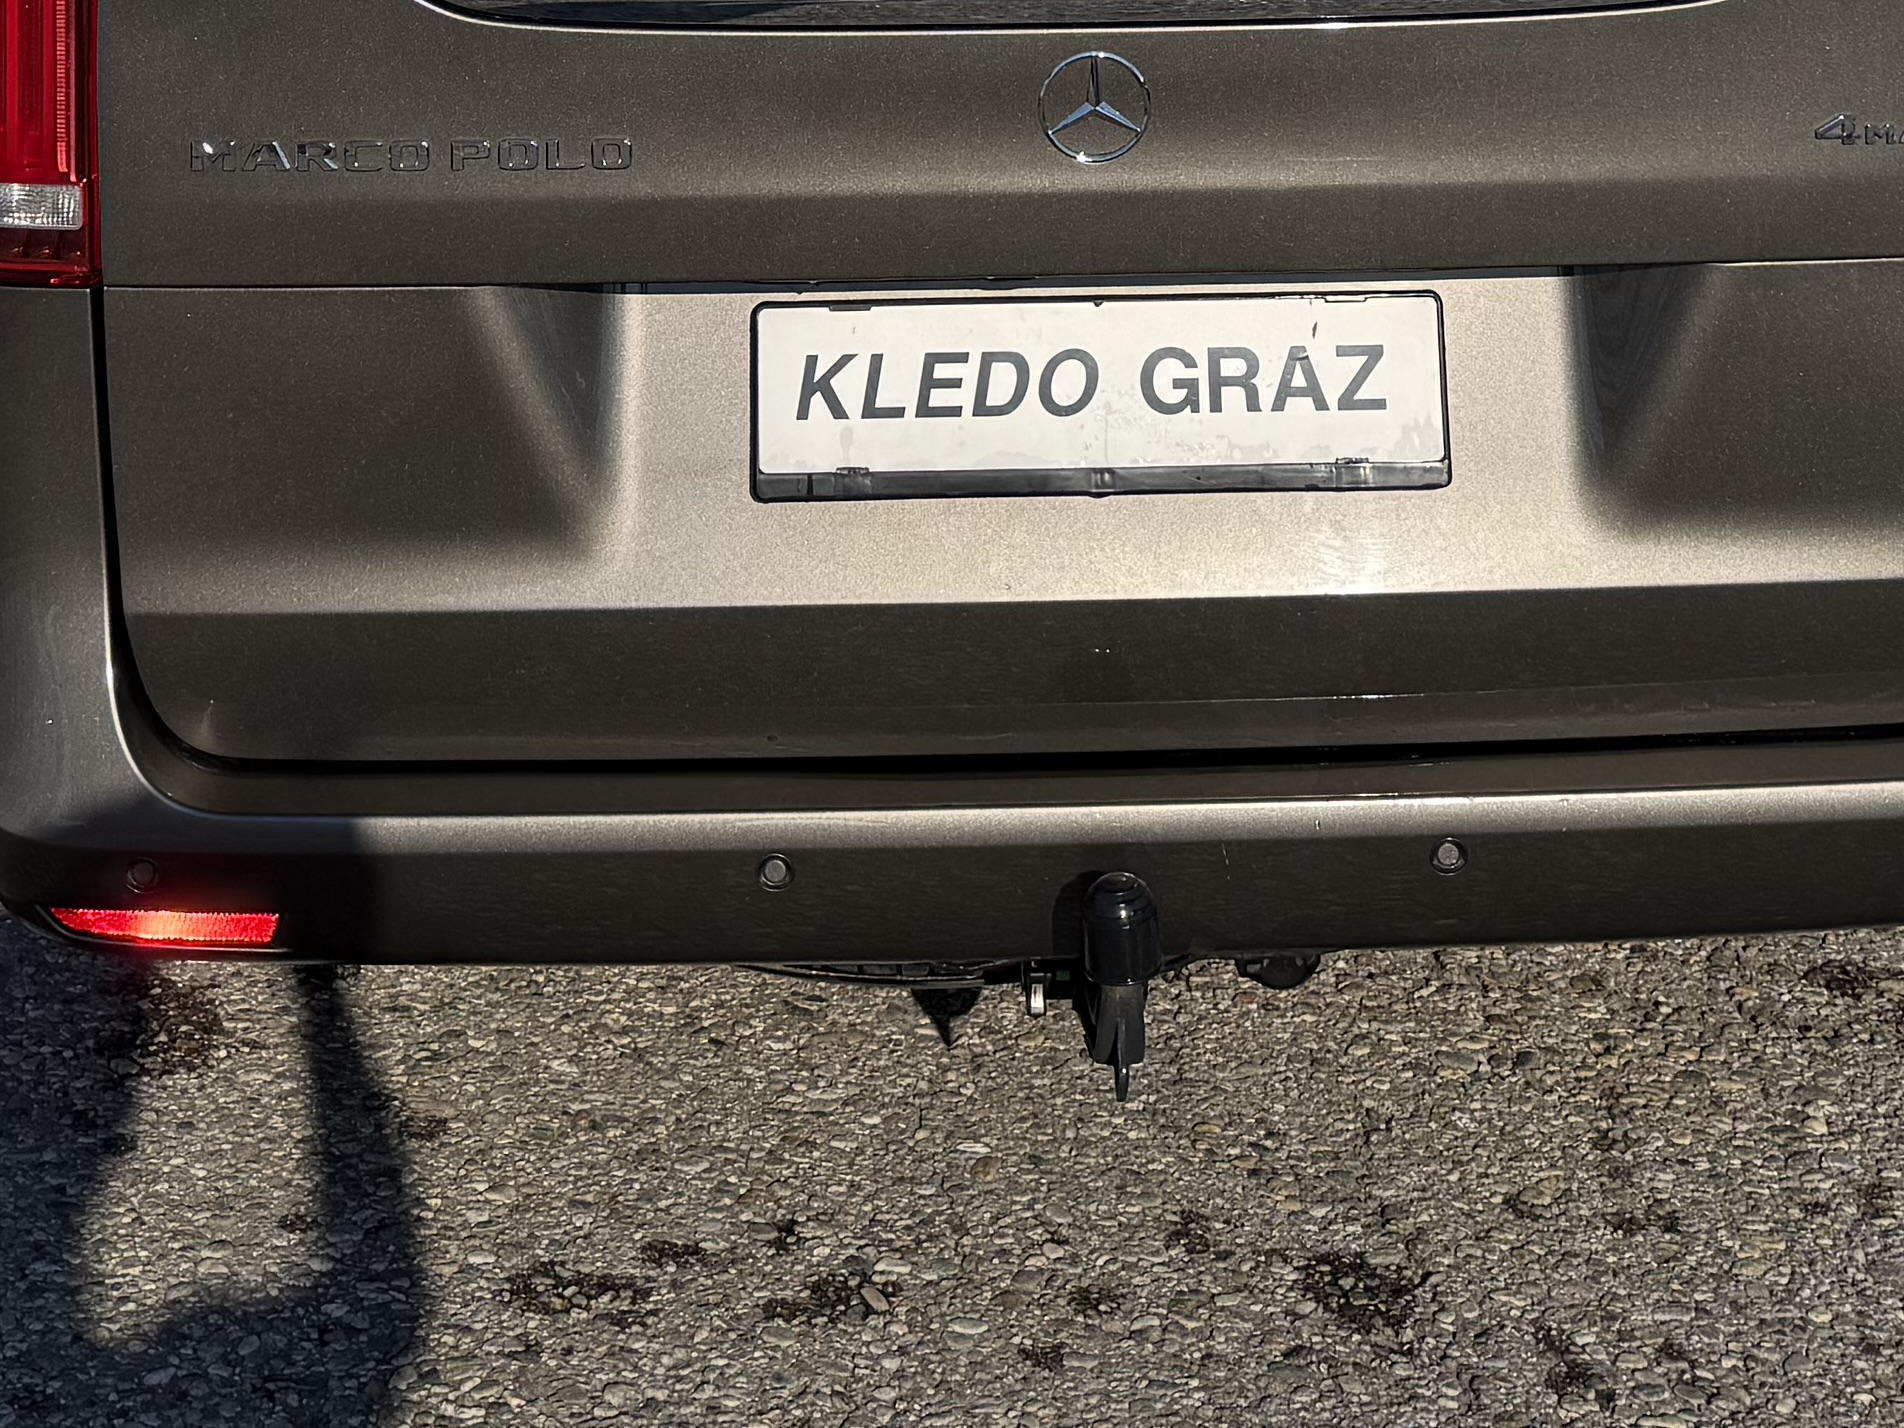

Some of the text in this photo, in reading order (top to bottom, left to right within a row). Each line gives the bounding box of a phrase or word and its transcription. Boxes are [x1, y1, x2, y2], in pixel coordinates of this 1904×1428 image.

[190, 137, 633, 173] MARCO POLO
[795, 344, 1388, 421] KLEDO GRAZ
